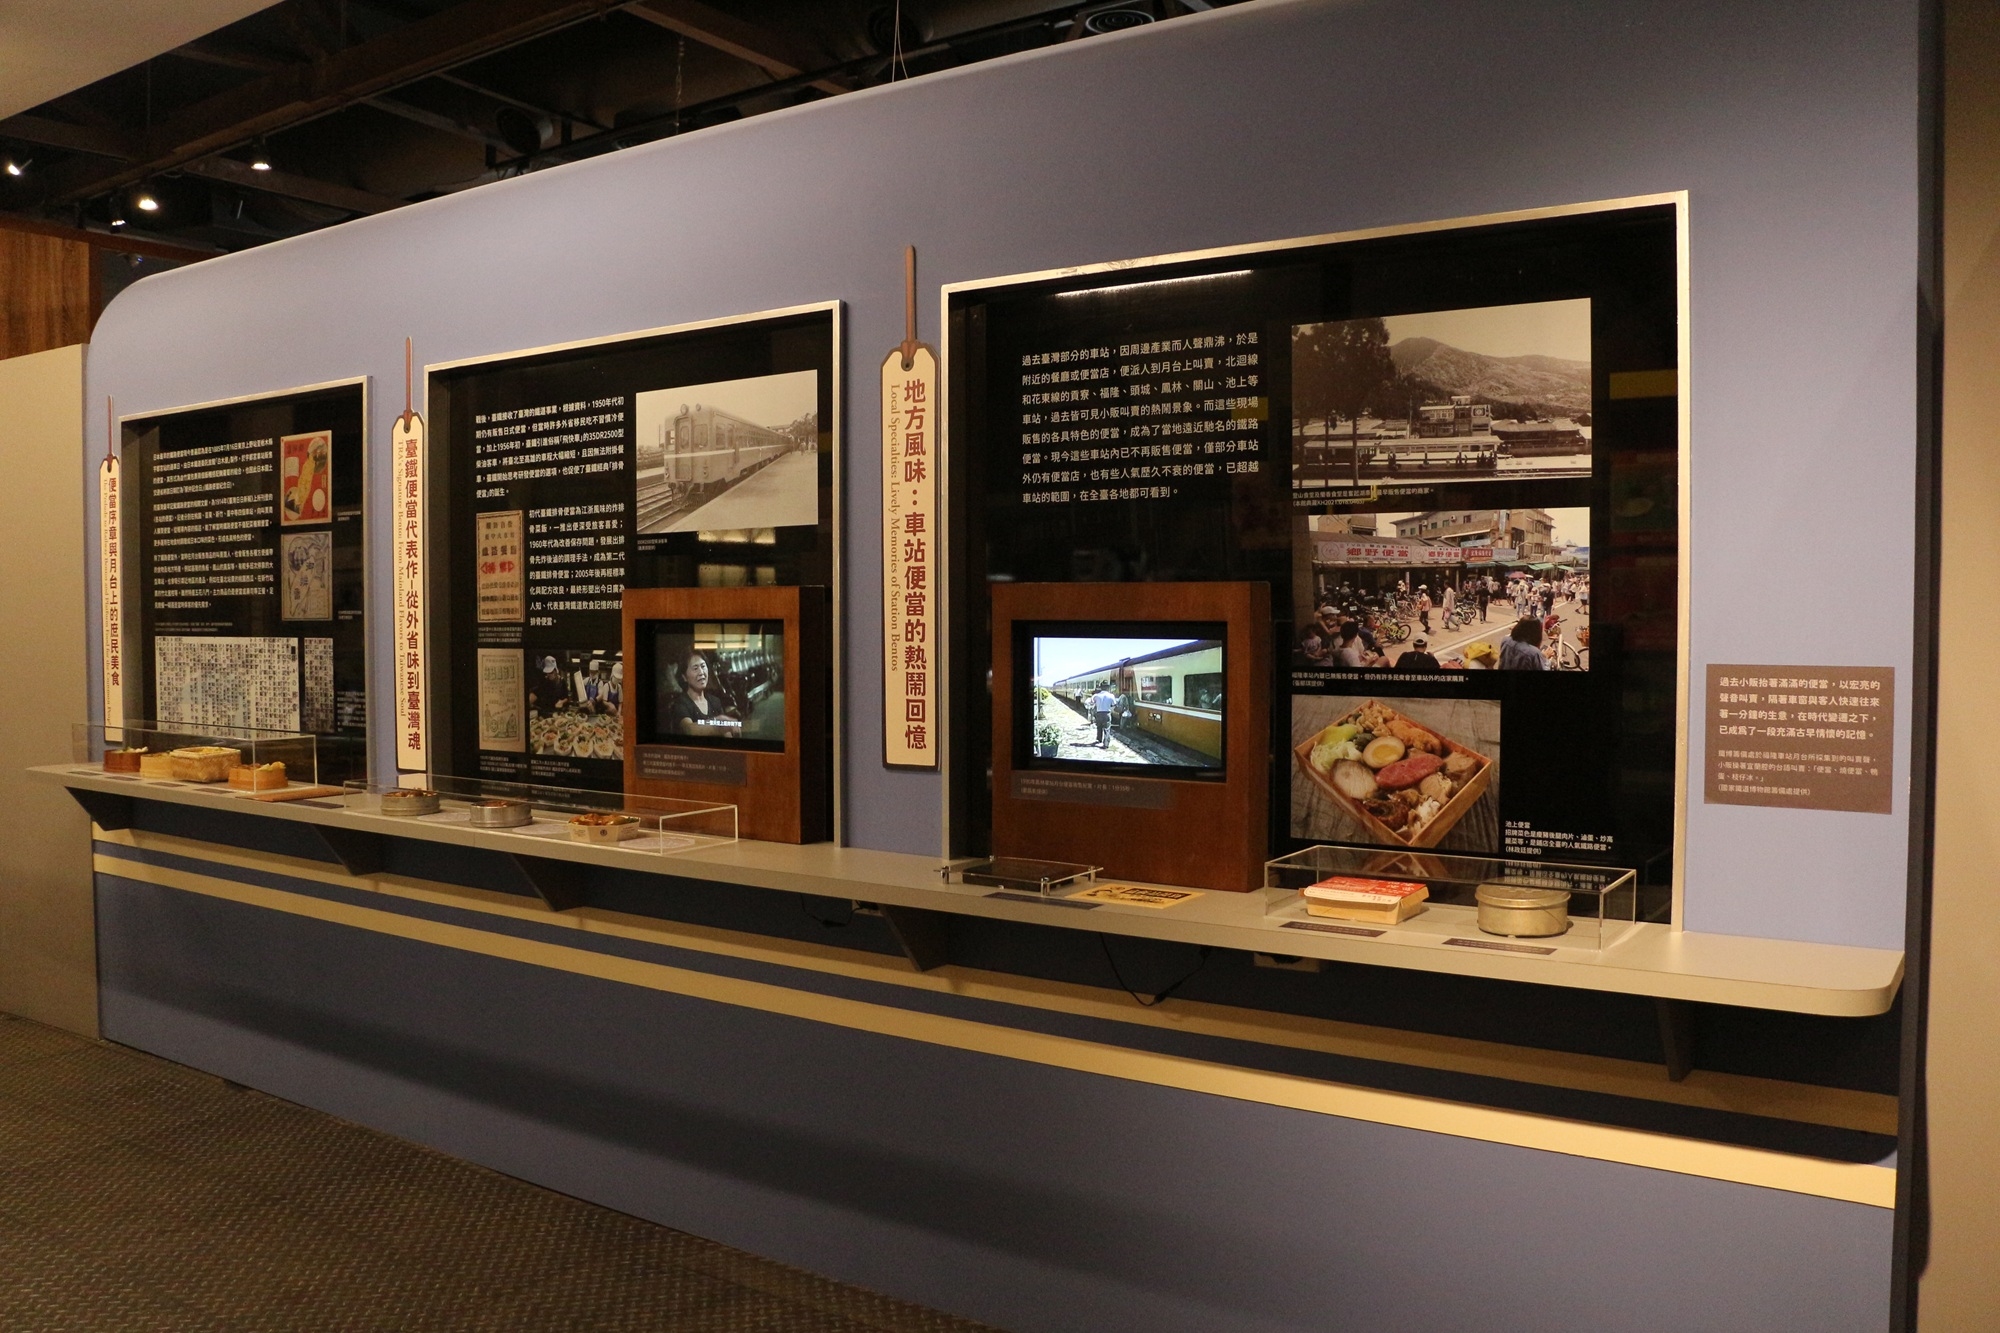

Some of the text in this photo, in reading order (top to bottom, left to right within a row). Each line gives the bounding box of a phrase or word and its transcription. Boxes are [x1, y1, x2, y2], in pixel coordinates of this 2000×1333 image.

[1022, 332, 1258, 366] 過去臺灣部分的車站，因周邊產業而人聲鼎沸，於是
[1022, 354, 1258, 386] 附近的餐廳或便當店，便派人到月台上叫賣，北迴線
[1022, 374, 1259, 405] 和花東線的貢寮、福隆、頭城、鳳林、關山、池上等
[1022, 396, 1259, 425] 車站，過去皆可見小販叫賣的熱鬧景象。而這些現場
[1022, 418, 1259, 445] 販售的各具特色的便當，成為了當地遠近馳名的鐵路
[1022, 439, 1259, 465] 便當。現今這些車站內已不再販售便當，僅部分車站
[1022, 461, 1259, 484] 外仍有便當店，也有些人氣歷久不衰的便當，已超越
[396, 468, 404, 509] Signature
[1022, 486, 1179, 504] 車站的範圍，在全臺各地都可看到。
[888, 384, 901, 672] Local Specialties: Lively Memories of Station Bentos
[904, 378, 927, 750] 地方風味：車站便當的熱鬧回憶
[1346, 547, 1410, 557] 鄉野便當
[108, 477, 120, 686] 便當序章與月台上的庶民美食
[1719, 676, 1881, 691] 過去小販抬著滿滿的便當，以宏亮的
[1719, 693, 1880, 708] 聲音叫賣，隔著車窗與客人快速往來
[1719, 708, 1878, 723] 著一分鐘的生意，在時代變遷之下，
[1505, 820, 1531, 829] 池上便當
